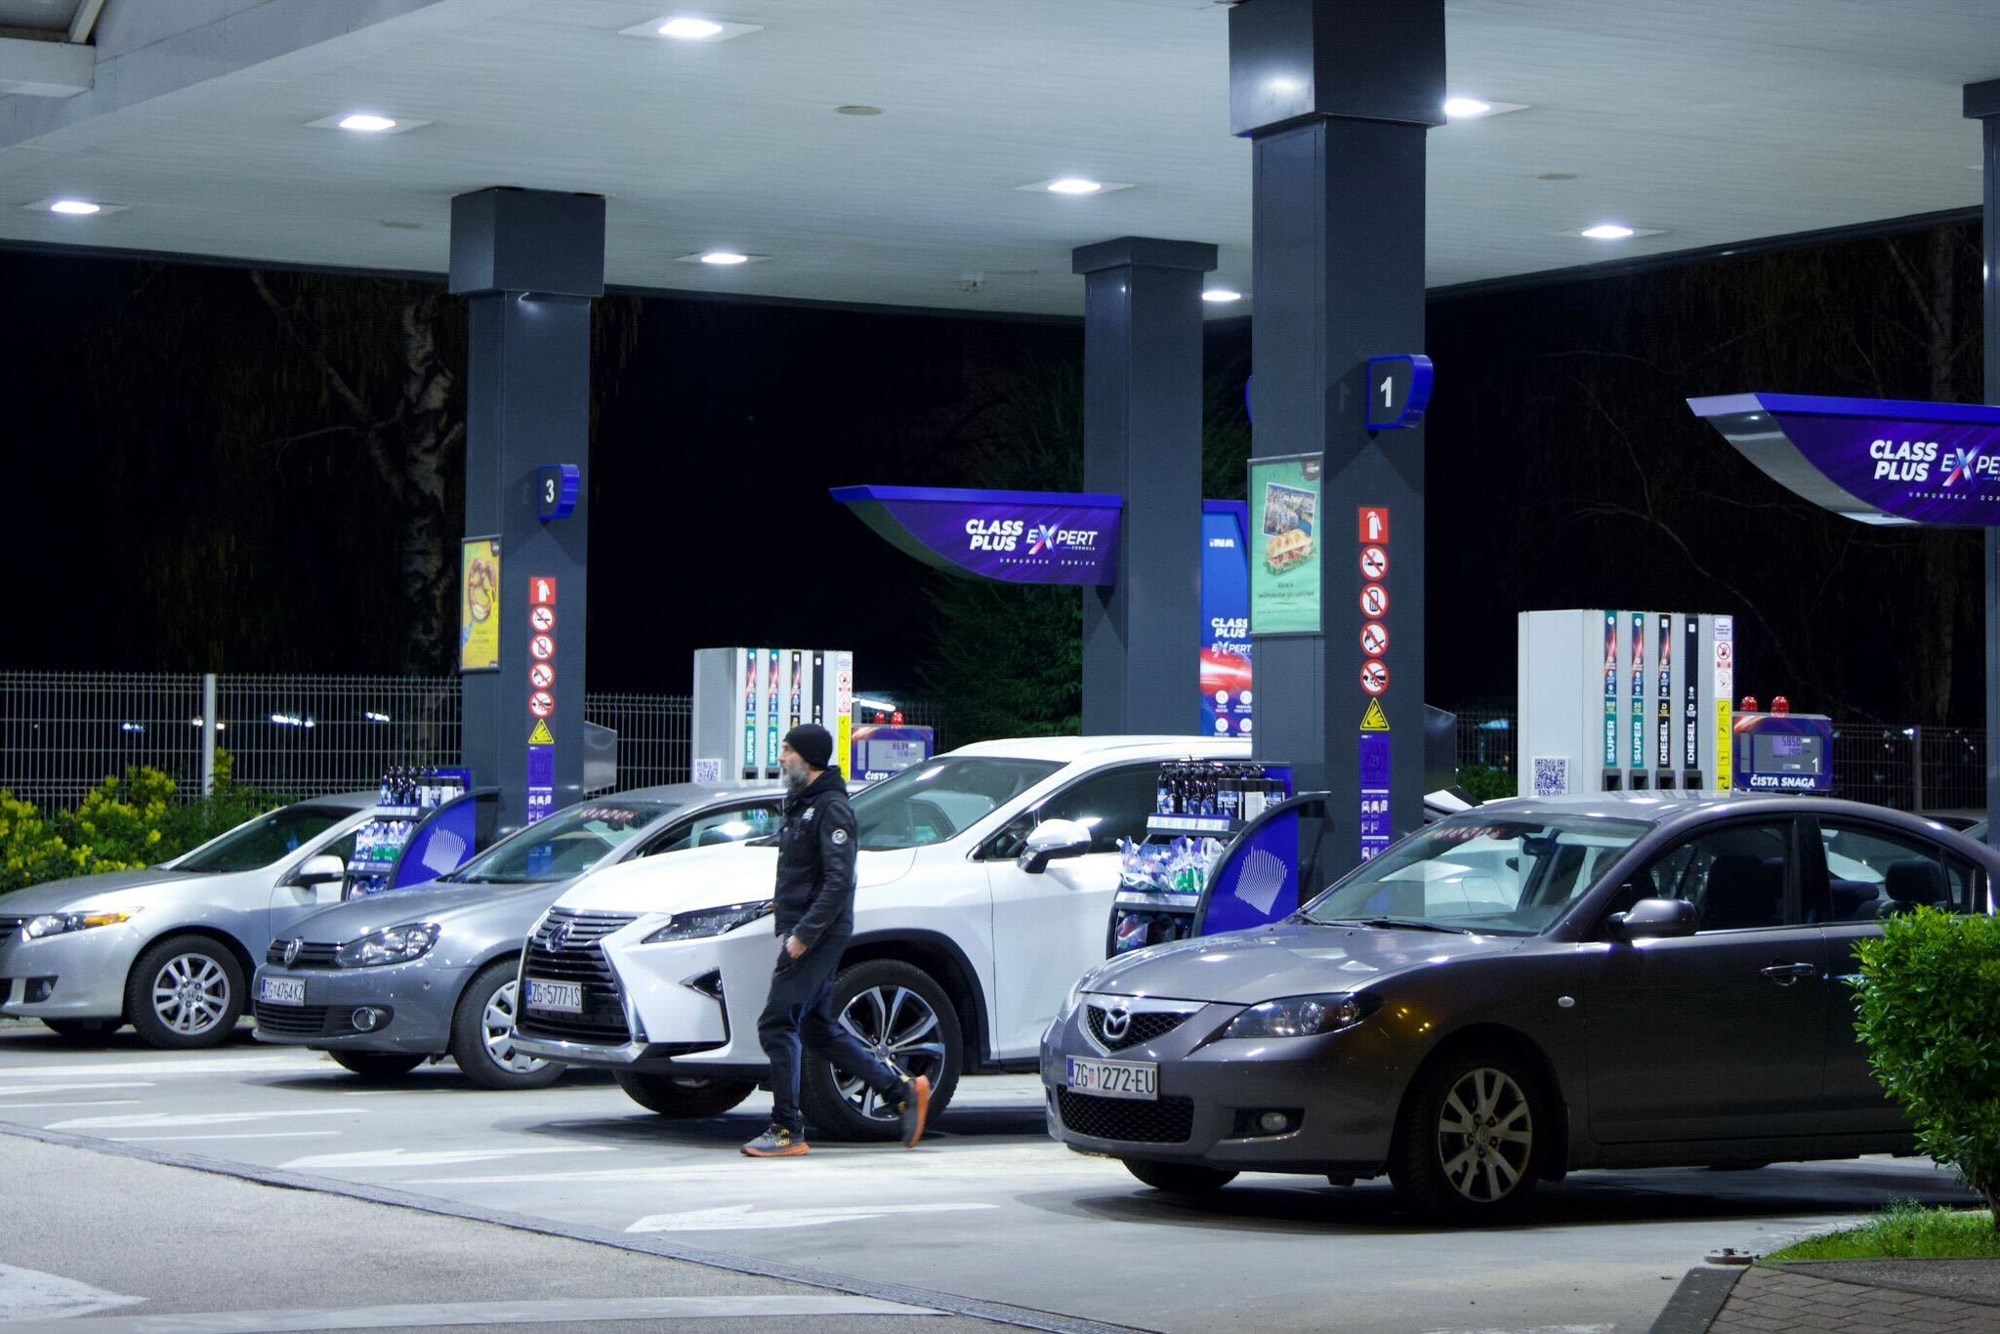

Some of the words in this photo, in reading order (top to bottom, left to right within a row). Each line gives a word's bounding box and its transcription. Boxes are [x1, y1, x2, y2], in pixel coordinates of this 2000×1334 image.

[1381, 376, 1391, 407] 1
[1869, 439, 1938, 461] CLASS
[1873, 460, 1930, 481] PLUS
[1940, 446, 2000, 487] EXPE
[546, 479, 554, 503] 3
[965, 519, 1024, 536] CLASS
[969, 535, 1017, 551] PLUS
[1025, 523, 1098, 555] EXPERT
[1211, 617, 1248, 628] CLASS
[1215, 627, 1246, 639] PLUS
[1211, 640, 1252, 658] EXPERT
[1606, 720, 1615, 760] SUPER
[1633, 721, 1642, 761] SUPER
[1660, 721, 1668, 761] DIESEL
[1687, 721, 1695, 761] DIESEL
[864, 770, 889, 781] ČISTA
[1811, 757, 1819, 773] 1
[1750, 774, 1778, 787] ČISTA
[1781, 776, 1815, 788] SNAGA
[533, 983, 543, 1003] ZG
[1075, 1063, 1088, 1087] ZG
[1097, 1066, 1156, 1094] 1272-EU
